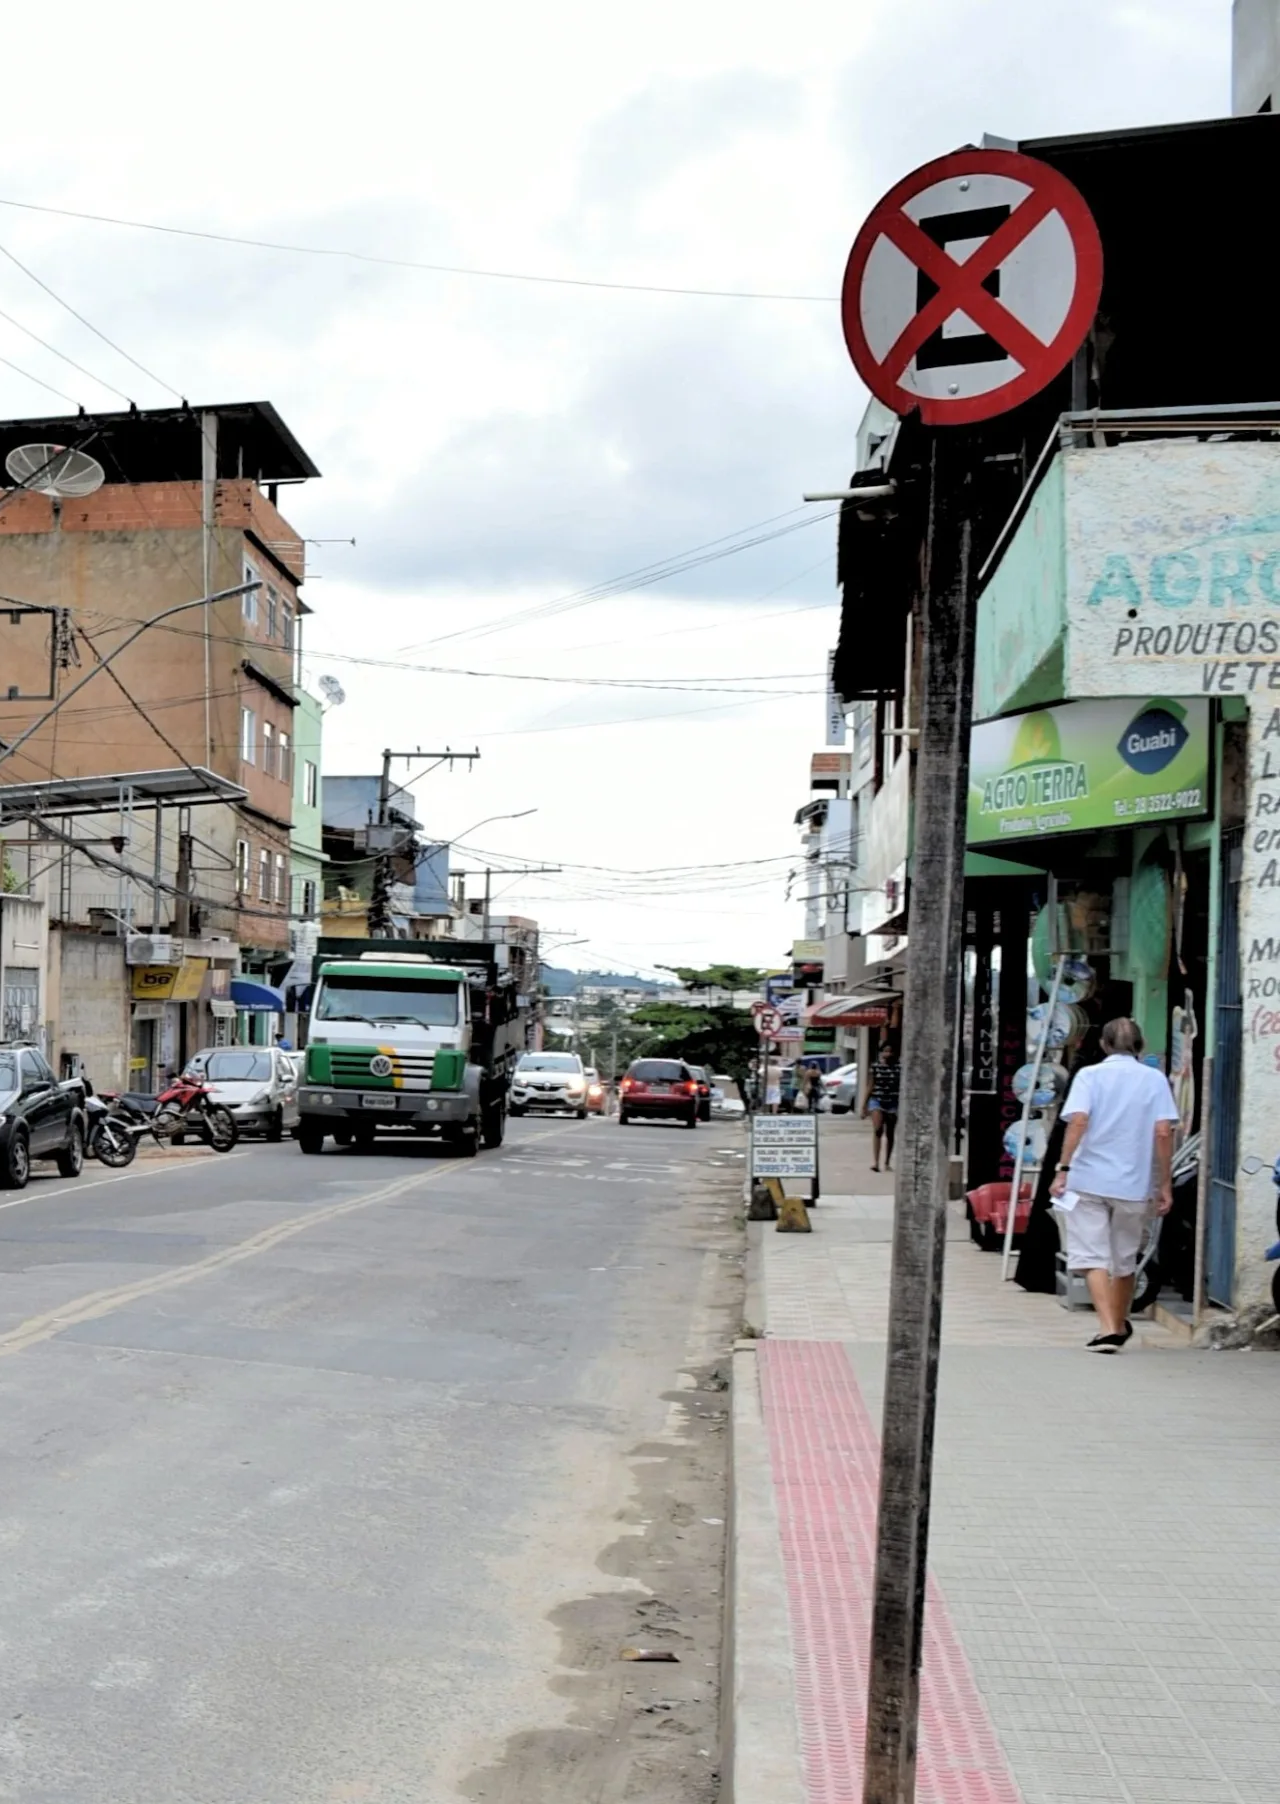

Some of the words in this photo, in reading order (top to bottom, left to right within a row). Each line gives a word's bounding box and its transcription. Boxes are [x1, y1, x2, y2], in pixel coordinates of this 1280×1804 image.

[1113, 621, 1279, 656] PRODUTOS
[1127, 728, 1176, 754] Guabi
[980, 774, 1027, 815] AGRO
[1031, 762, 1089, 807] TERRA
